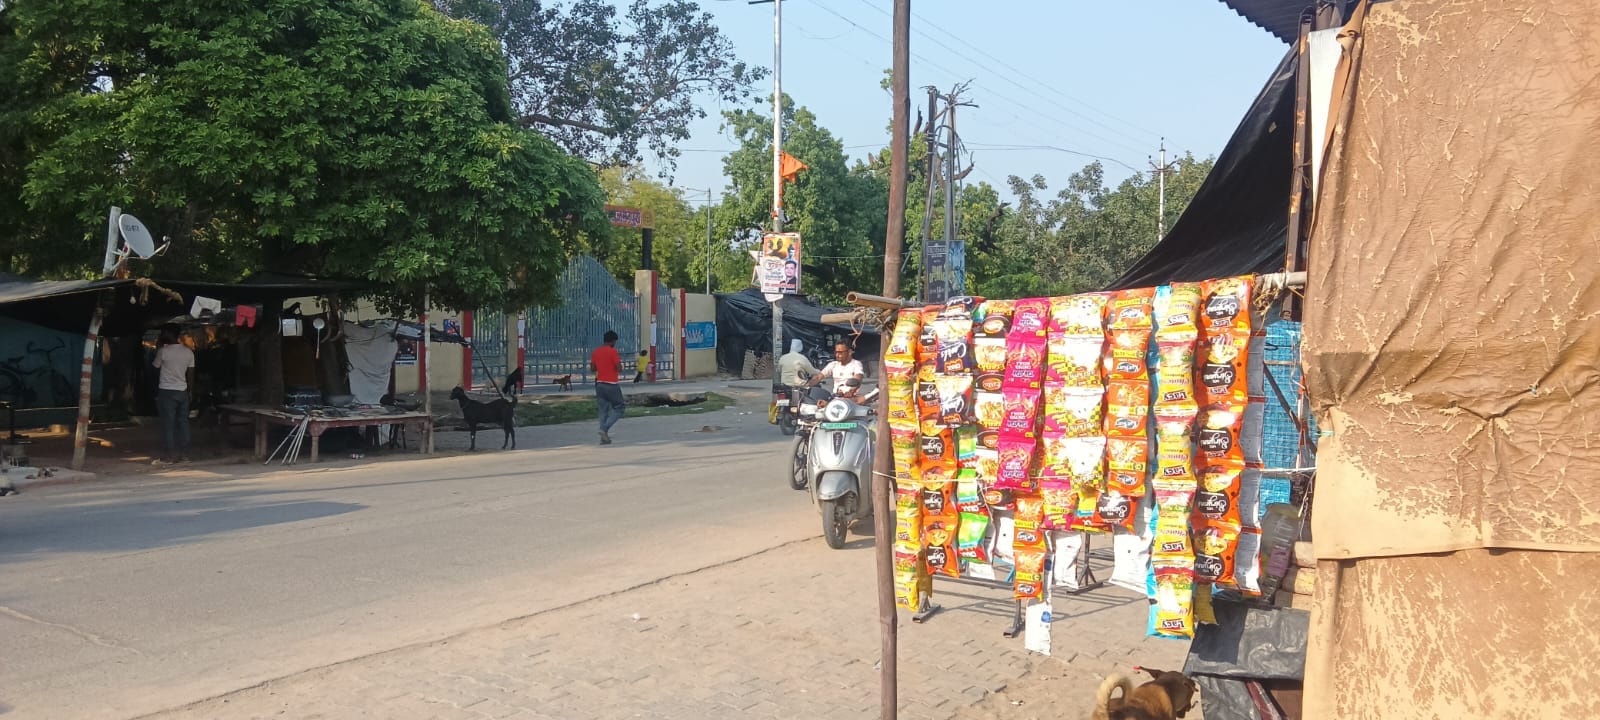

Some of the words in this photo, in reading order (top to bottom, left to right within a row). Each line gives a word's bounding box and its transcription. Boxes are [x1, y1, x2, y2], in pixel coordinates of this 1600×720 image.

[1164, 391, 1188, 401] Lacy
[1200, 433, 1230, 449] Biryani
[1164, 466, 1187, 475] Lacy
[1162, 543, 1185, 552] Lacy
[1162, 620, 1185, 629] Lacy
